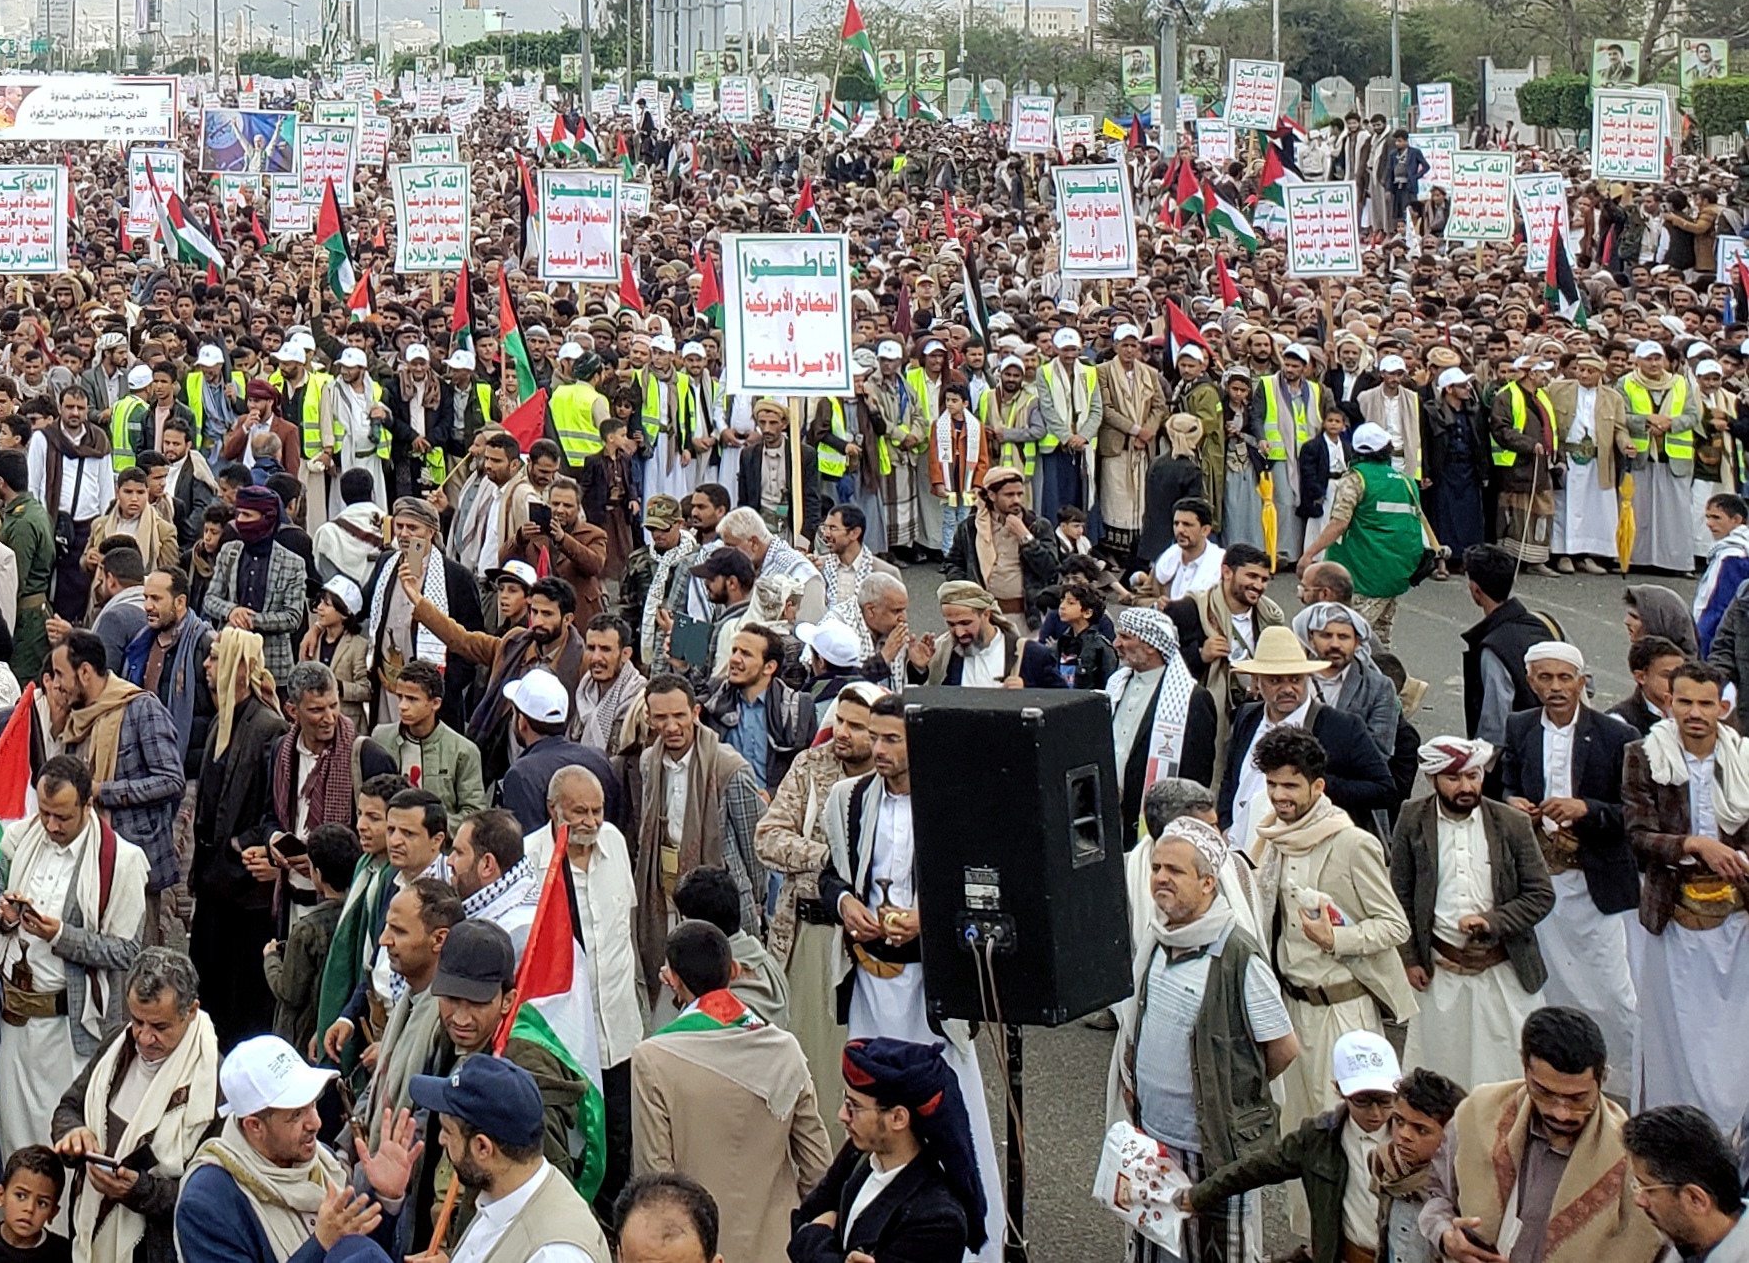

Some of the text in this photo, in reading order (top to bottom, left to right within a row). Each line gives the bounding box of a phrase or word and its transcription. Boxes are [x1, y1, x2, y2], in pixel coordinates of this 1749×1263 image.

[32, 174, 53, 191] الله
[406, 168, 463, 195] الله أكبر
[26, 197, 53, 210] الموت
[438, 195, 463, 208] الموت
[439, 214, 463, 225] الموت
[547, 204, 611, 226] البضائع الأمريكية
[1066, 204, 1121, 221] البضائع الأمريكية
[26, 215, 52, 229] الموت
[17, 234, 28, 246] على
[32, 234, 52, 244] اللعنة
[409, 232, 463, 244] اللعنة على اليهود
[577, 230, 581, 243] و
[25, 248, 53, 267] النصر
[408, 246, 465, 266] النصر للإسلام
[548, 250, 612, 269] الإسرائيلية
[1068, 244, 1125, 261] الإسرائيلية
[745, 287, 838, 317] البضائع الأمريكية
[788, 322, 794, 341] و
[748, 351, 841, 377] الإسرائيلية
